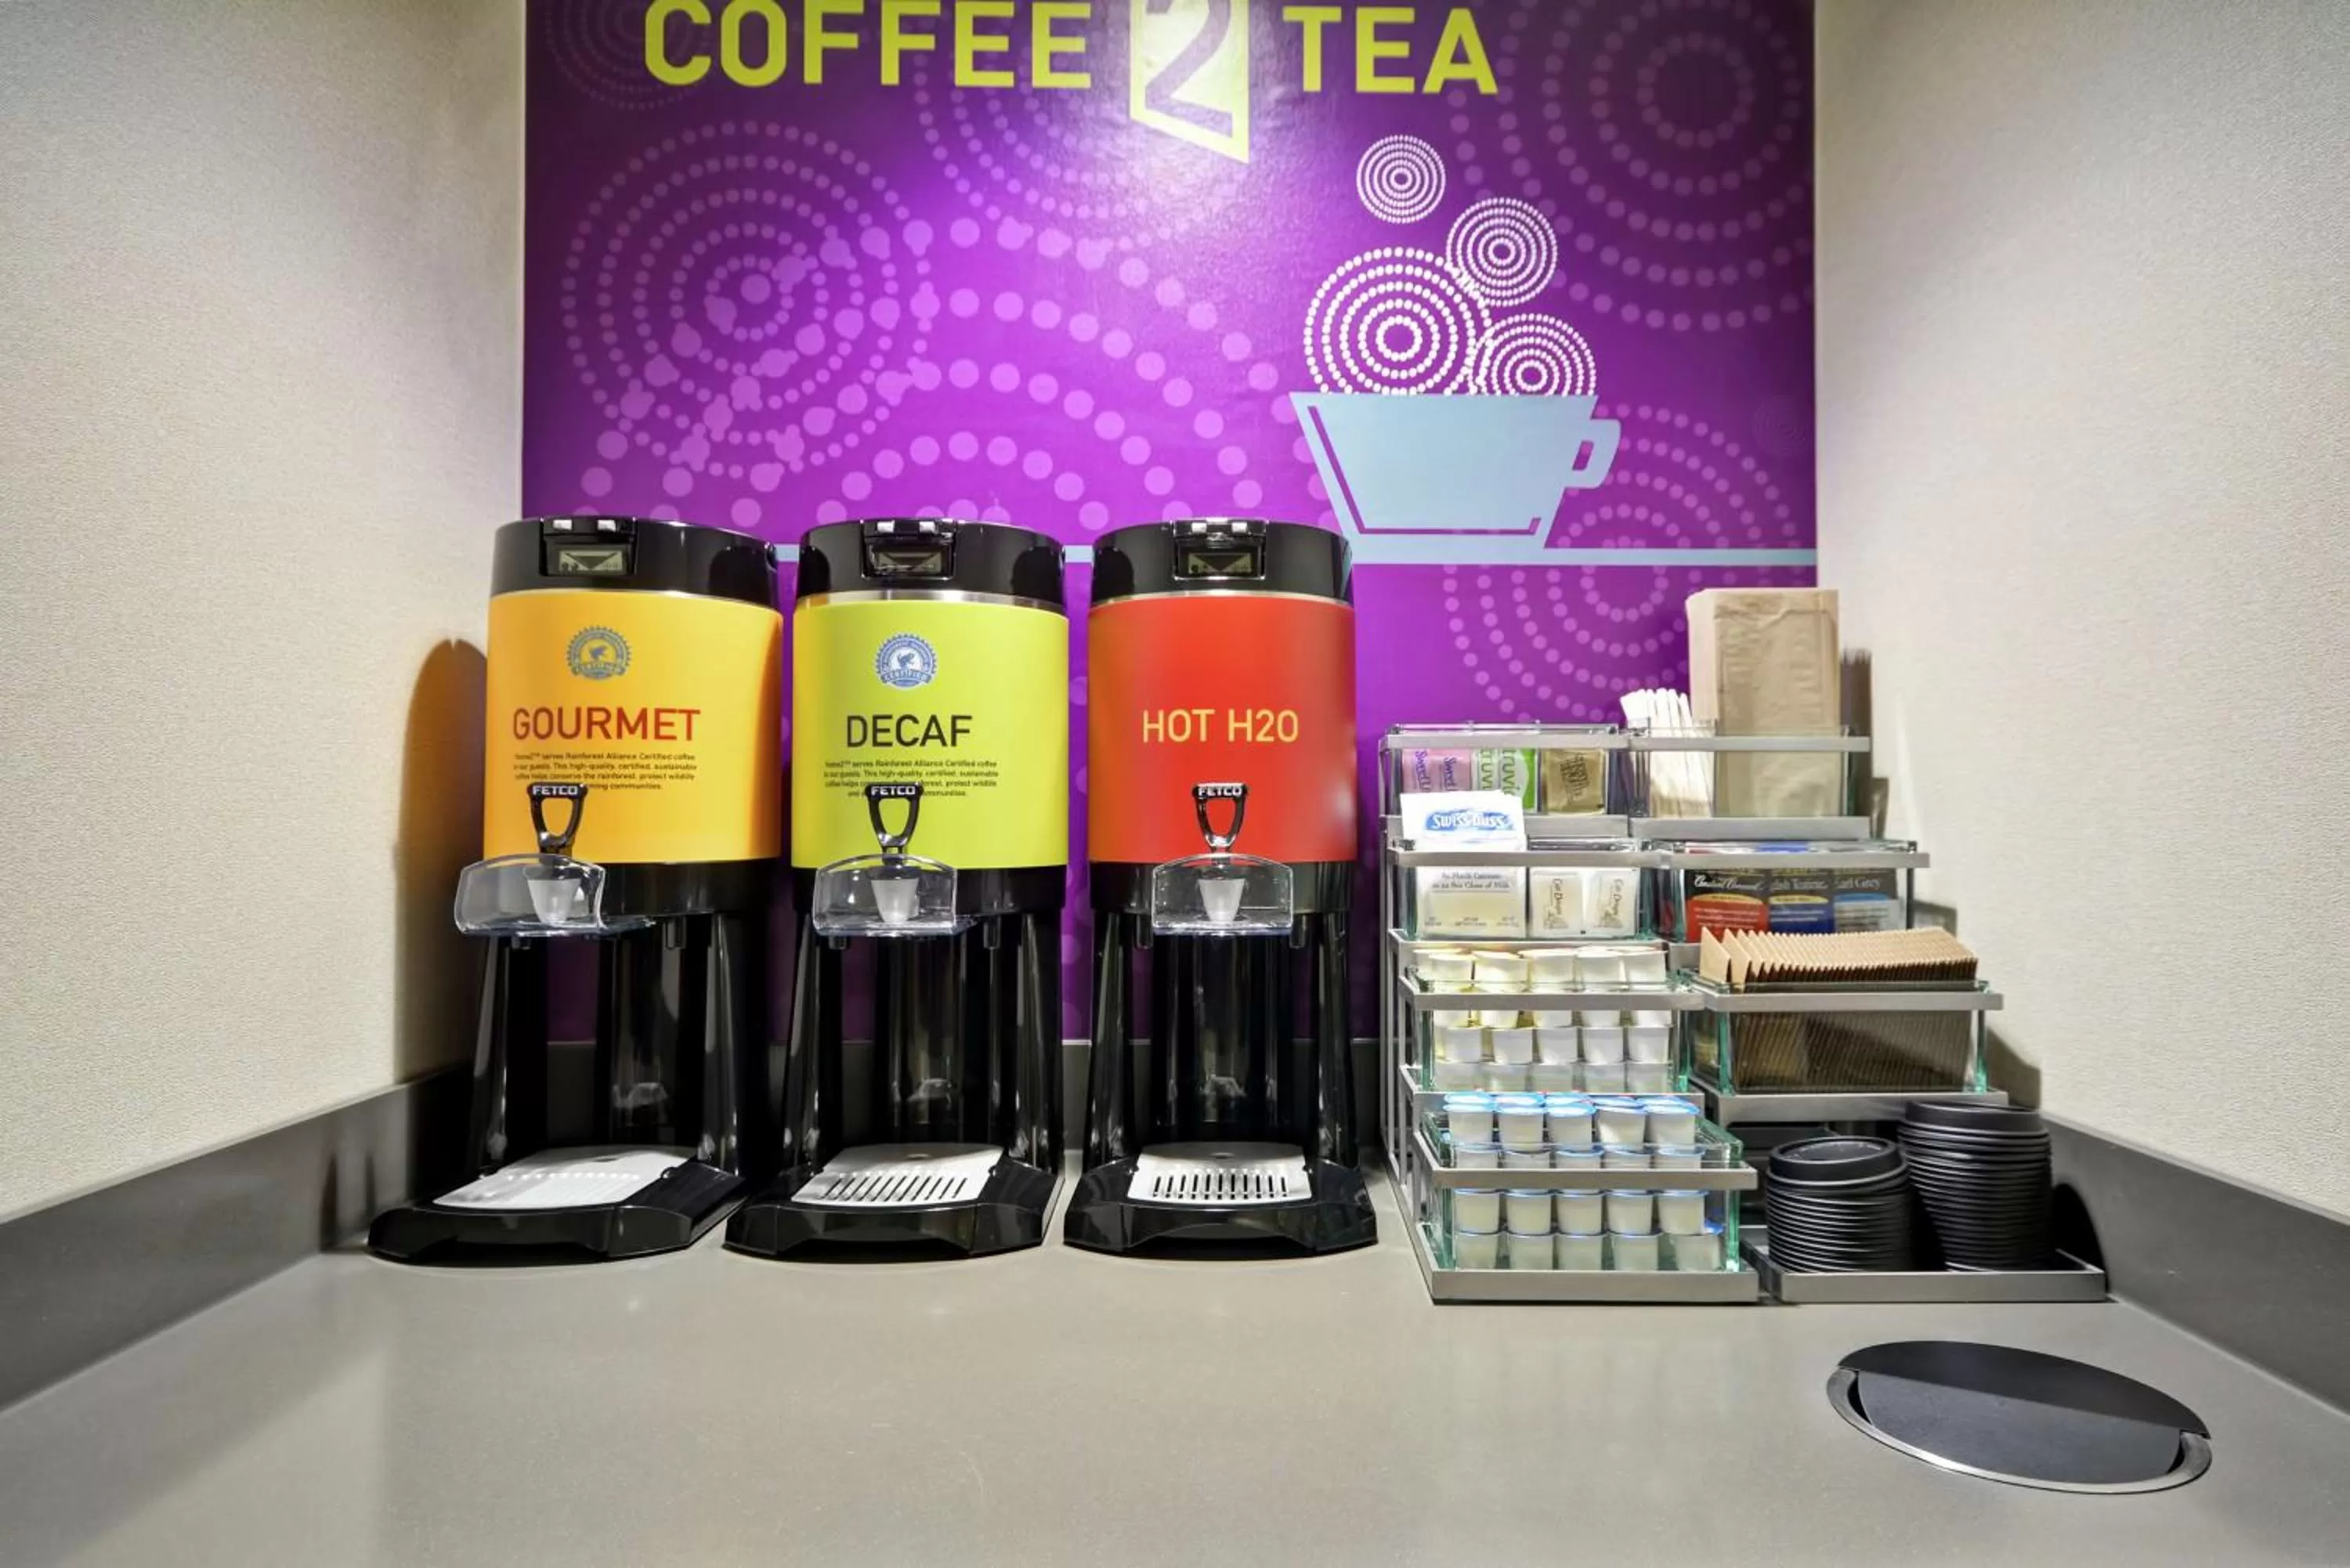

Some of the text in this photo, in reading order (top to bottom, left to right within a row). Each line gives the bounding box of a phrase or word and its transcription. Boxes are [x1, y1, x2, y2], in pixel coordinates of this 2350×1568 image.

[645, 0, 1092, 88] COFFEE
[1282, 6, 1498, 94] TEA
[513, 706, 701, 741] GOURMET
[847, 714, 973, 748] DECAF
[1143, 708, 1216, 743] HOT
[533, 786, 578, 796] FETCO
[871, 786, 916, 796] FETCO
[1198, 786, 1242, 797] FETCO
